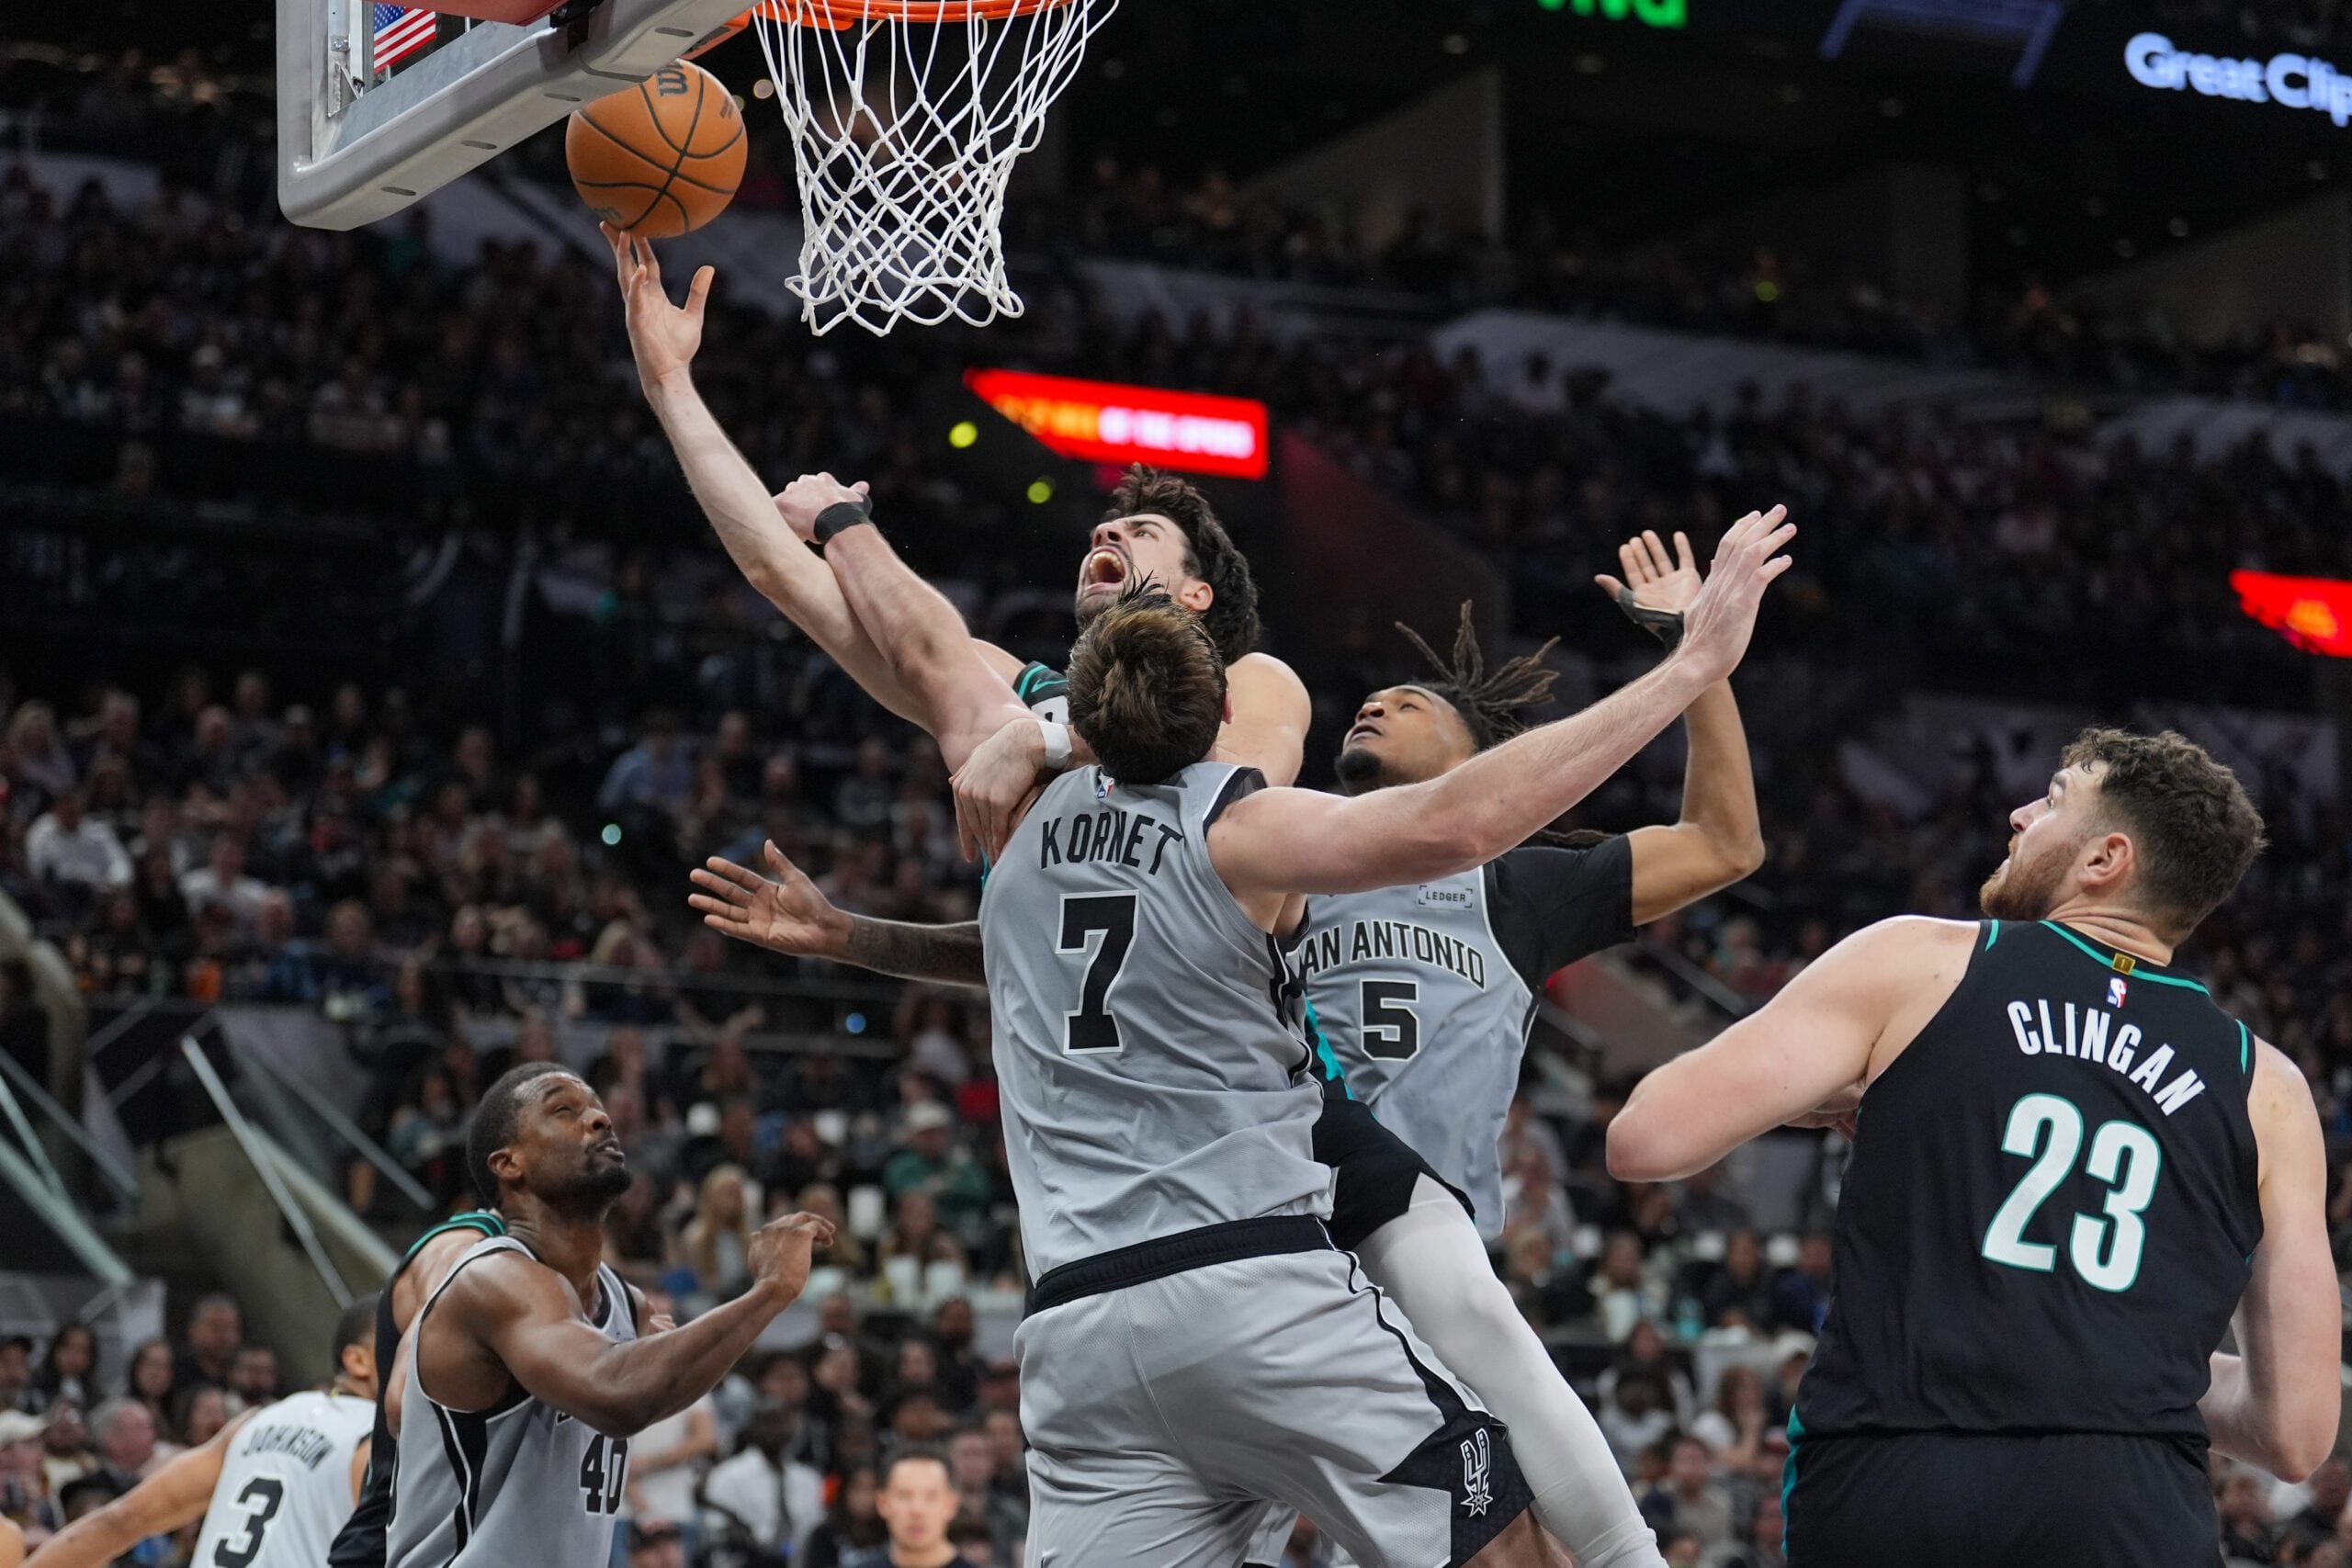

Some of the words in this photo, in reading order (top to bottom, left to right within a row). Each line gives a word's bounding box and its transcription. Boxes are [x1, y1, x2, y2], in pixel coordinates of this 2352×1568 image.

[1041, 811, 1184, 875] KORNET
[1425, 890, 1466, 902] LEDGER
[1056, 889, 1139, 1055] 7
[1299, 924, 1342, 979] AN
[1349, 919, 1487, 993] ANTONIO
[1360, 978, 1419, 1063] 5
[2007, 998, 2205, 1116] CLINGAN
[1981, 1092, 2162, 1292] 23
[579, 1432, 628, 1516] 40
[211, 1473, 286, 1568] 3
